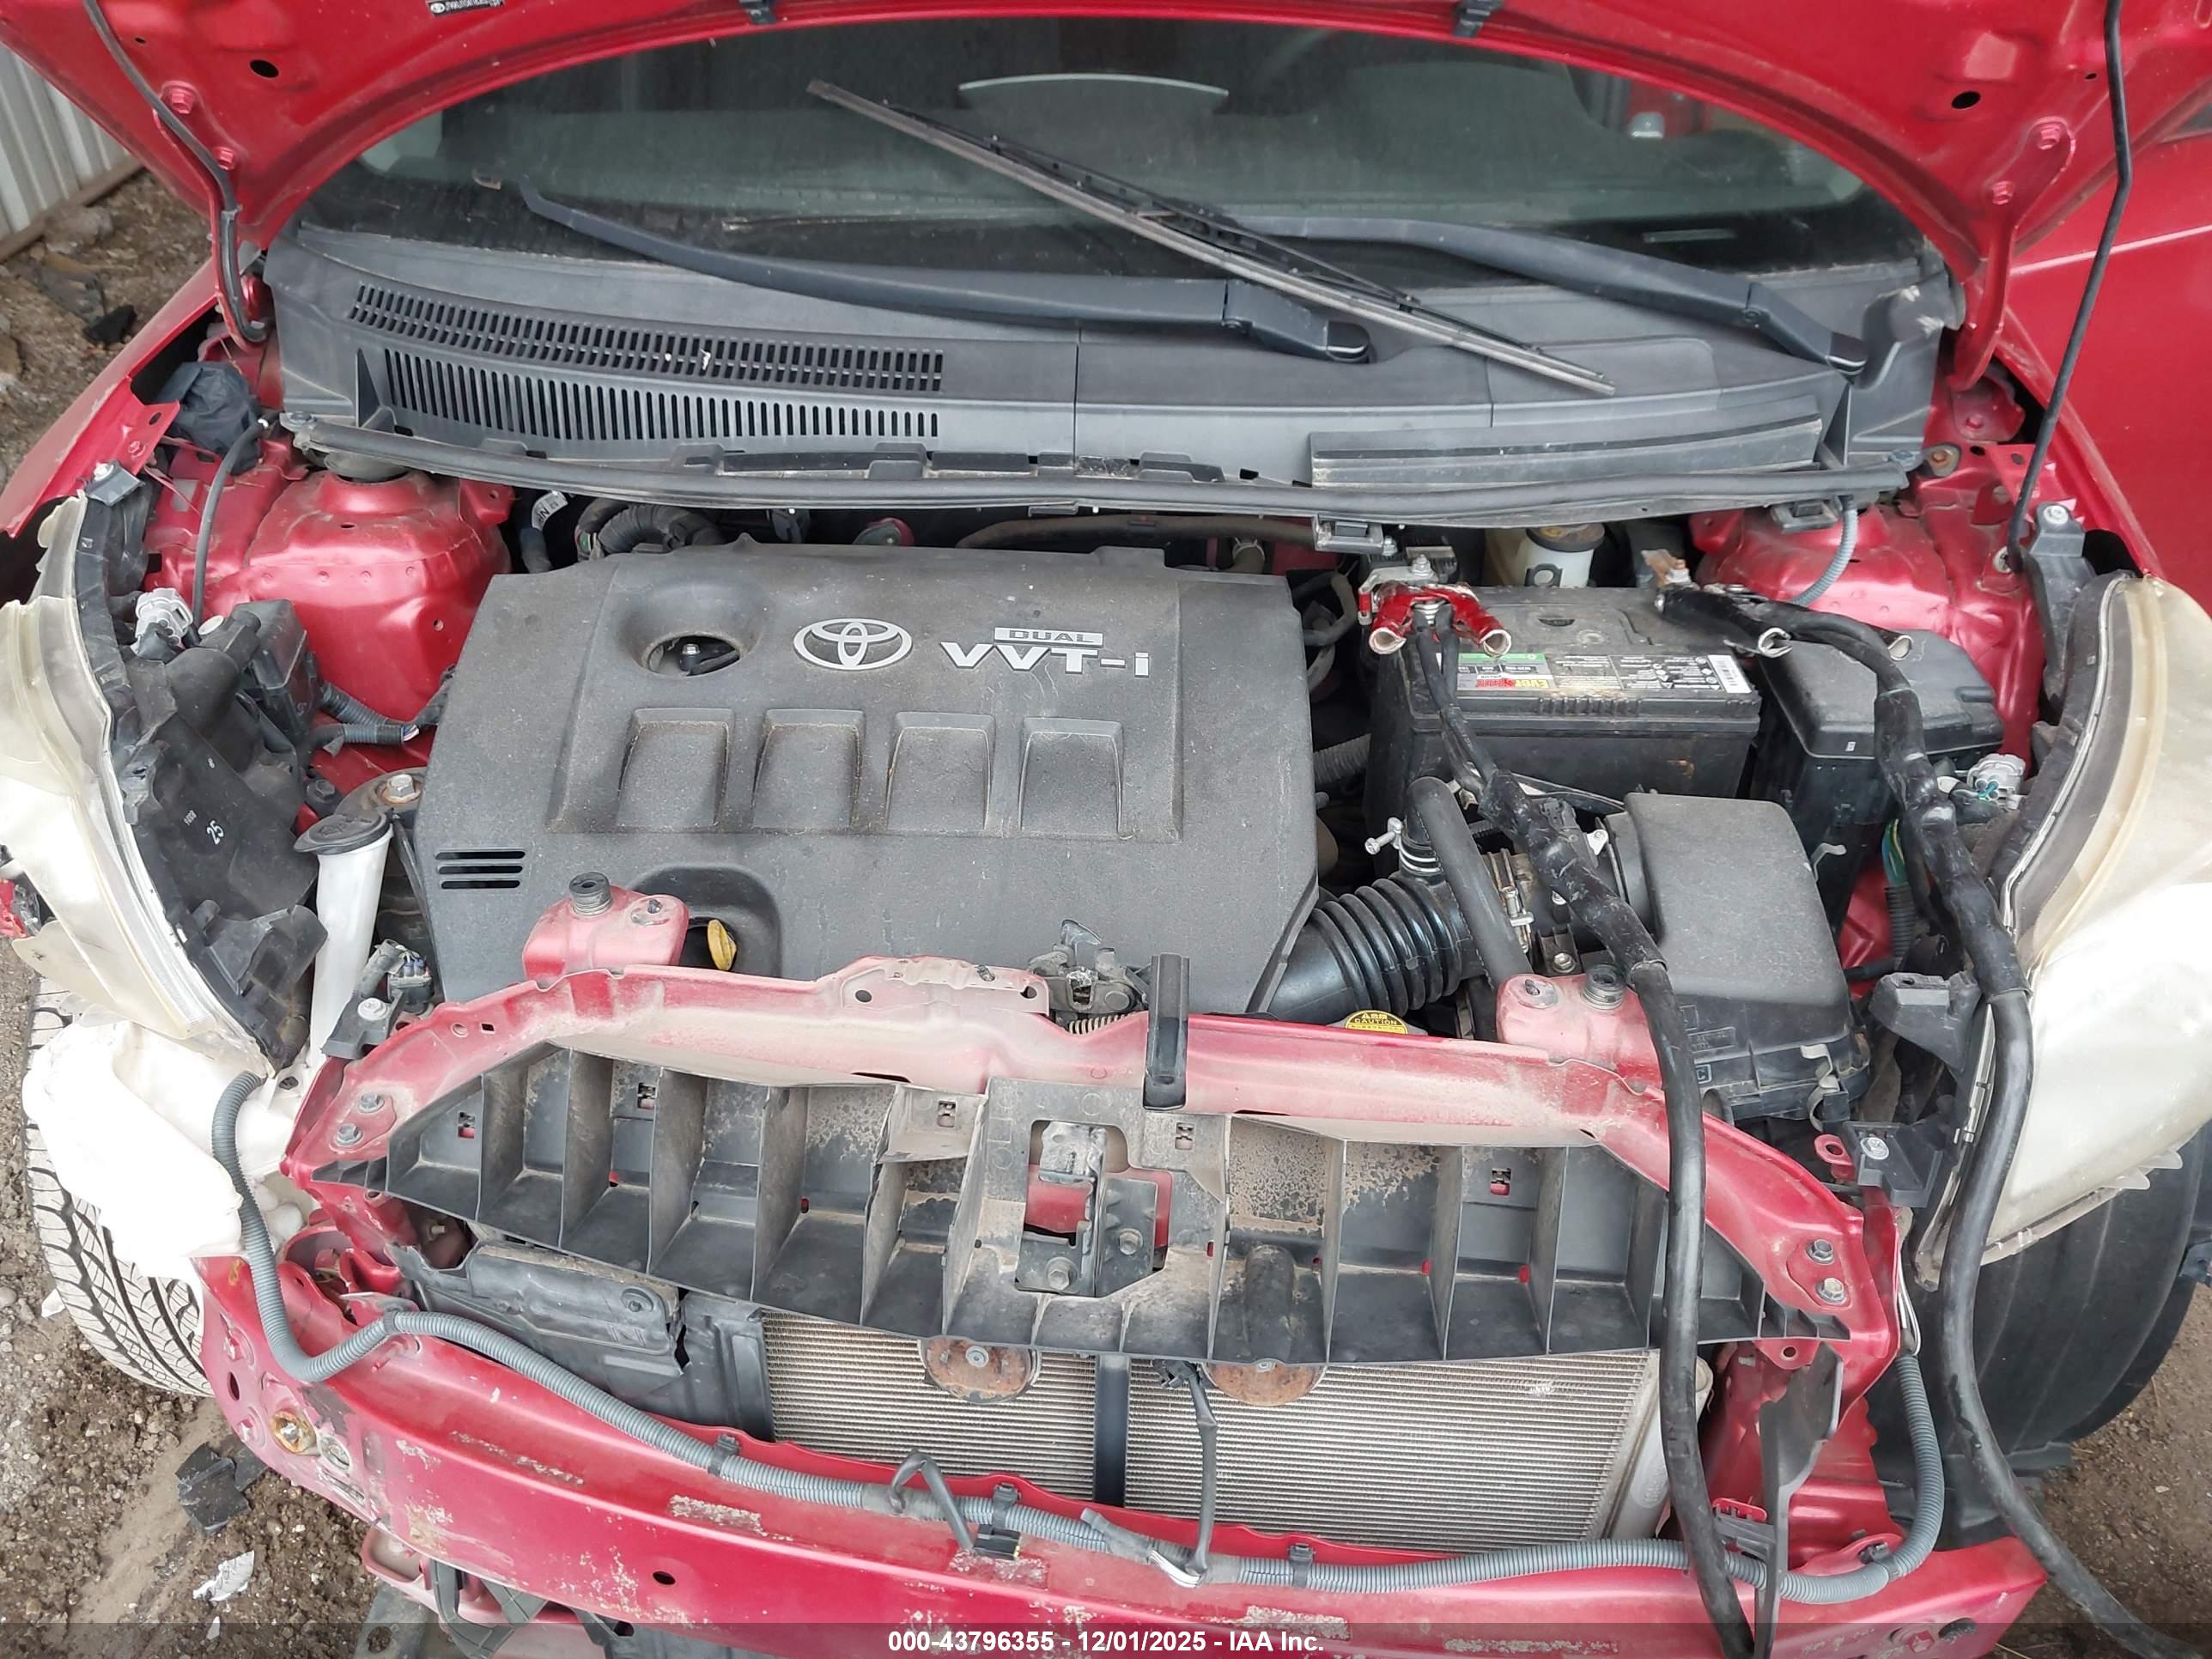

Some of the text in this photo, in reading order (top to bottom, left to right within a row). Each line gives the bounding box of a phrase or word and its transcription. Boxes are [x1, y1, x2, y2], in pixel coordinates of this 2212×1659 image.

[1008, 629, 1097, 644] DUAL
[940, 641, 1151, 678] VVT-i
[206, 820, 224, 845] 25
